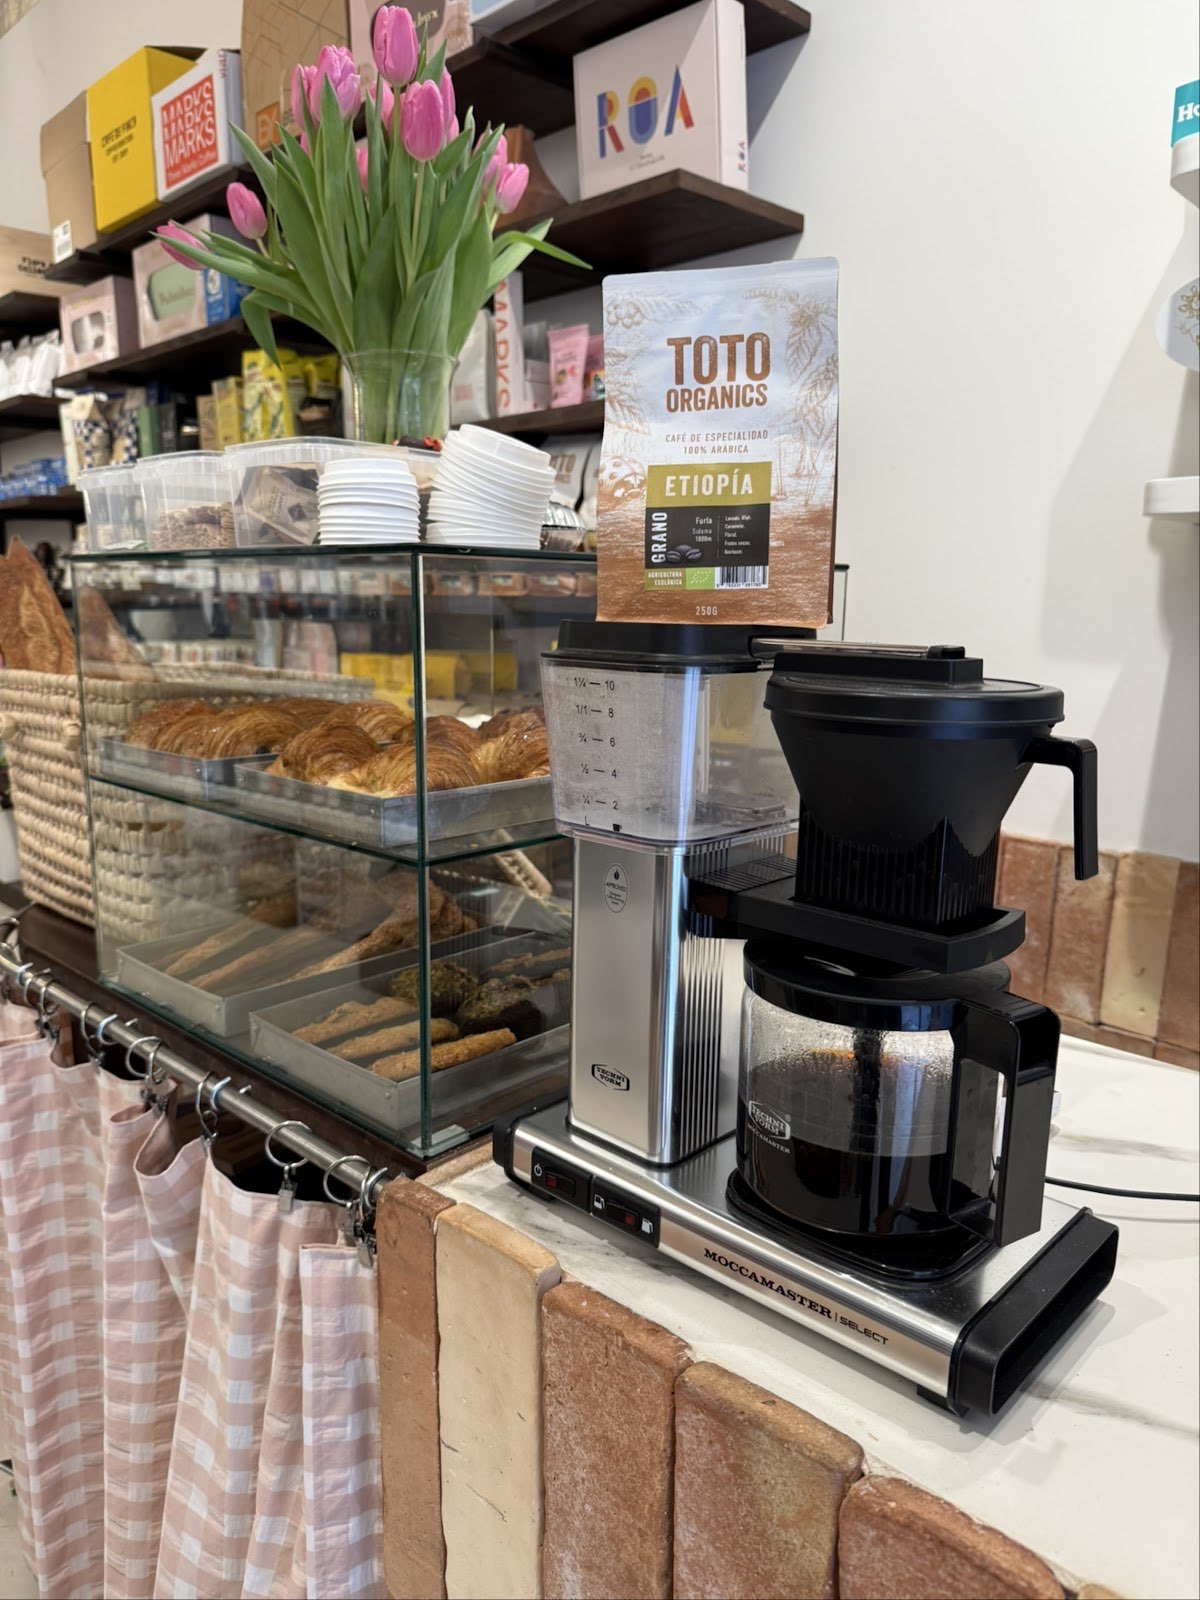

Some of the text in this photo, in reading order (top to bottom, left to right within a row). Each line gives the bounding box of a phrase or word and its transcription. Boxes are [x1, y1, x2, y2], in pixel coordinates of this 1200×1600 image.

[597, 64, 695, 159] ROA
[165, 117, 216, 168] MARKS
[667, 332, 771, 385] TOTO
[666, 383, 768, 413] ORGANICS
[665, 429, 769, 443] CAFÉ DE ESPECIALIDAD
[683, 442, 749, 455] 100% ARÁBICA
[665, 468, 753, 497] ETIOPÍA
[651, 512, 668, 563] GRANO
[695, 606, 718, 615] 250G
[605, 680, 615, 691] 10
[575, 704, 614, 718] 1/1 8
[609, 737, 615, 747] 6
[611, 769, 617, 778] 4
[612, 800, 618, 810] 2
[584, 816, 590, 826] L
[596, 1066, 625, 1083] TECHNI
[600, 1073, 622, 1087] VORM
[752, 1104, 784, 1130] TECHNI
[754, 1114, 779, 1135] VORM
[704, 1248, 889, 1345] MOCCAMASTER SELECT
